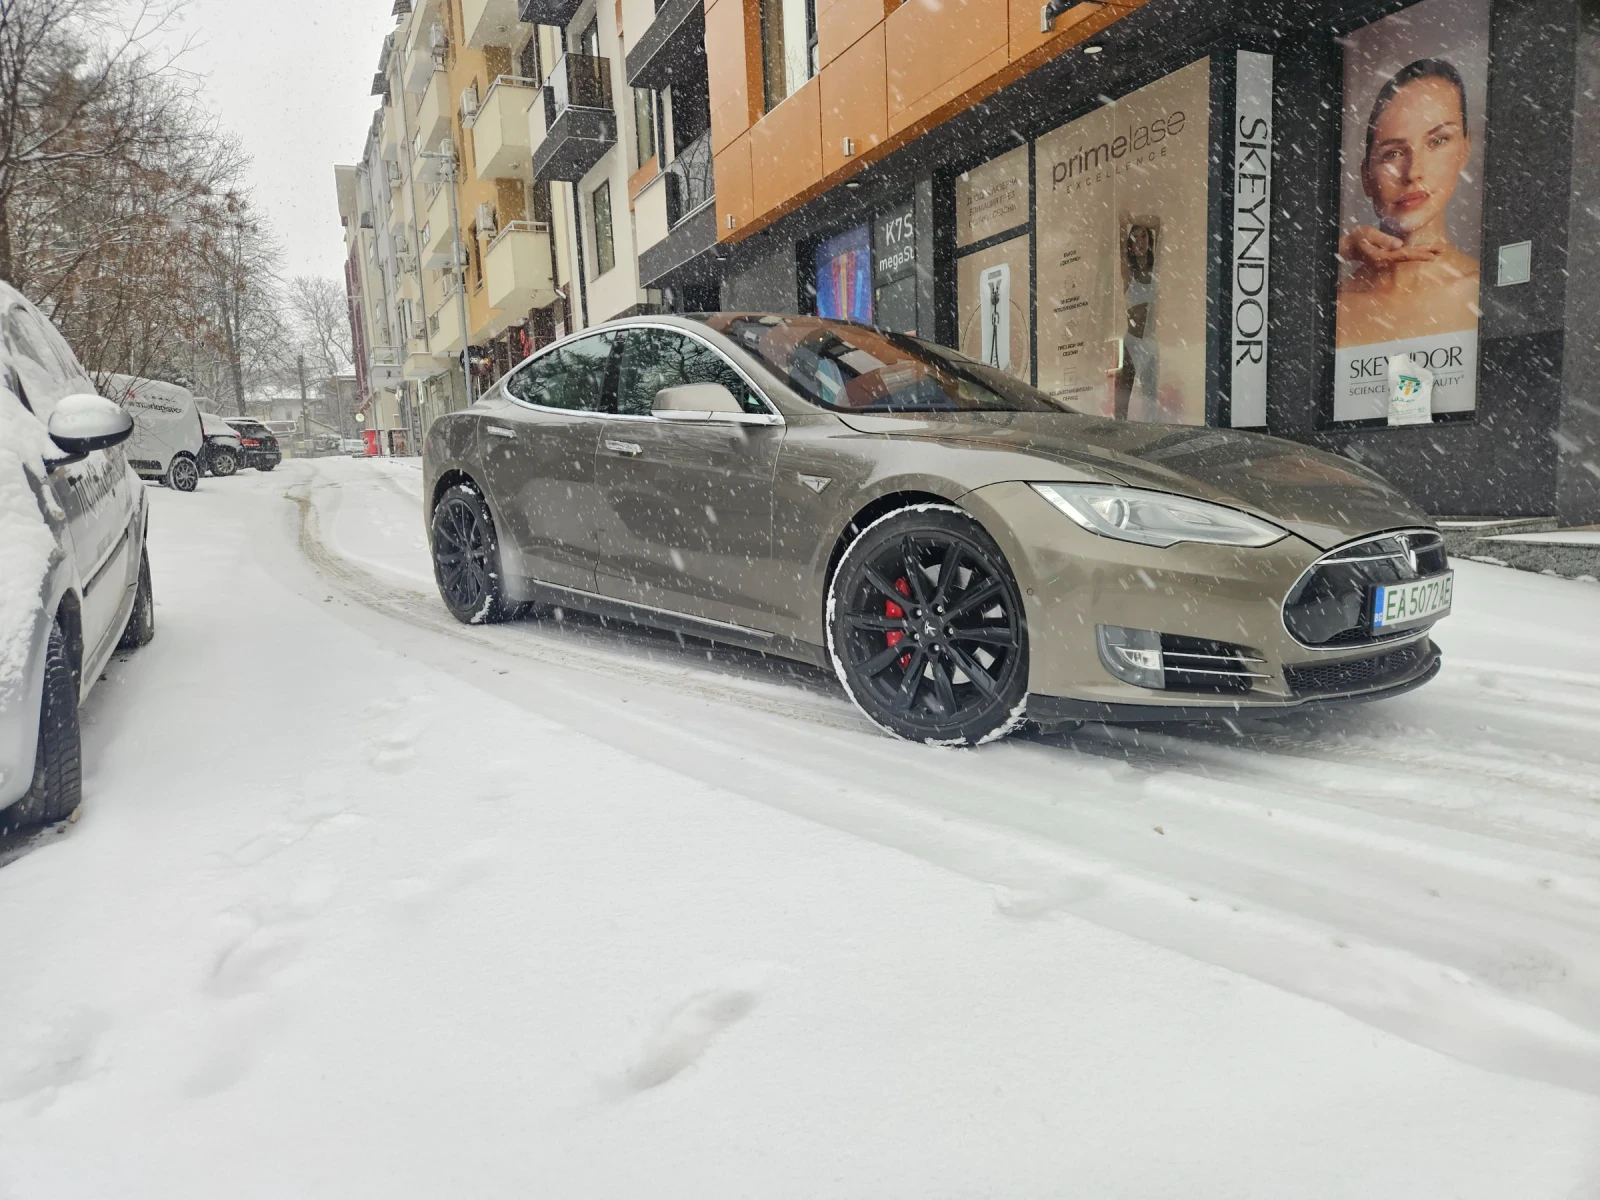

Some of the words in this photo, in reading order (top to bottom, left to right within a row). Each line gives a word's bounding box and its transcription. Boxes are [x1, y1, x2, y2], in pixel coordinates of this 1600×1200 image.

[1052, 110, 1186, 191] primelase
[1066, 146, 1168, 194] EXCELLENCE
[1235, 116, 1271, 367] SKEYNDOR
[1349, 346, 1463, 379] SKEDOR
[1349, 385, 1386, 396] SCIENCE
[1374, 612, 1383, 623] BG
[1385, 589, 1406, 621] EA
[1409, 581, 1439, 616] 5072
[1438, 577, 1451, 606] AE
